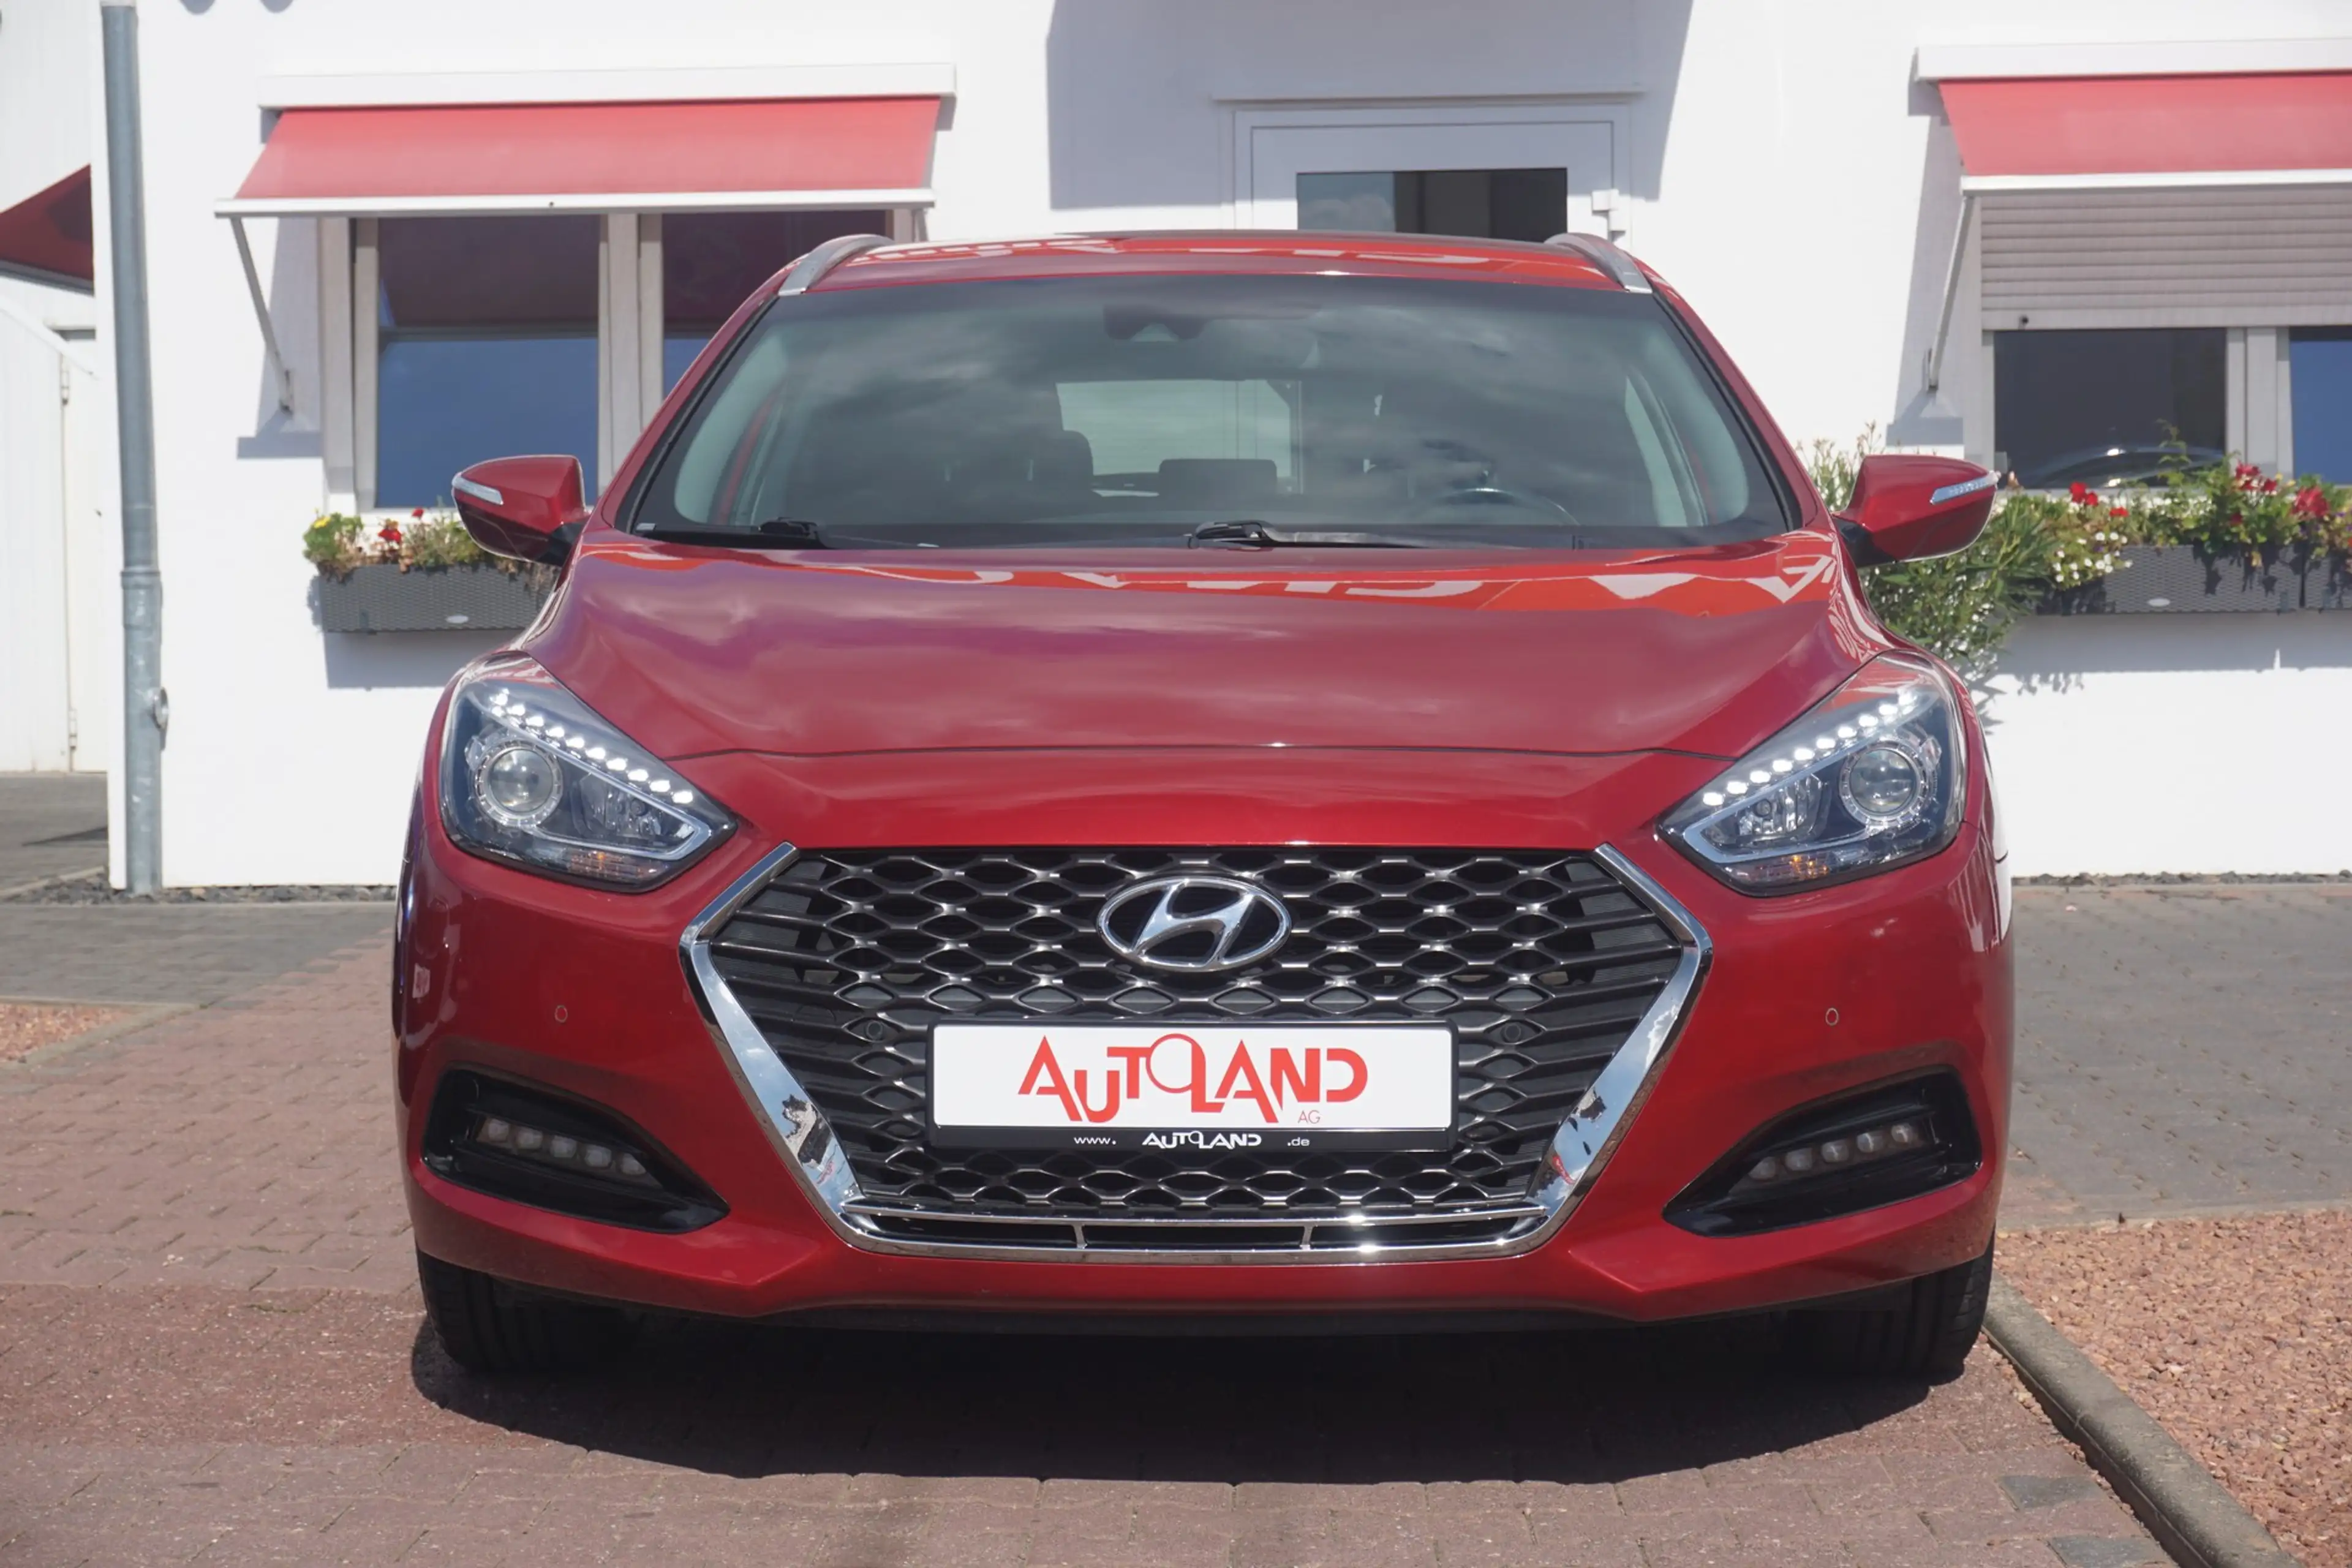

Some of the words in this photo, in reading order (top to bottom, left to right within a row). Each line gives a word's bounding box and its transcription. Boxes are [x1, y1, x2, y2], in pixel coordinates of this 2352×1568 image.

[1018, 1033, 1368, 1123] AUTOLAND
[1297, 1110, 1321, 1124] AG
[1142, 1131, 1262, 1150] AUTOLAND
[1287, 1137, 1310, 1147] .de
